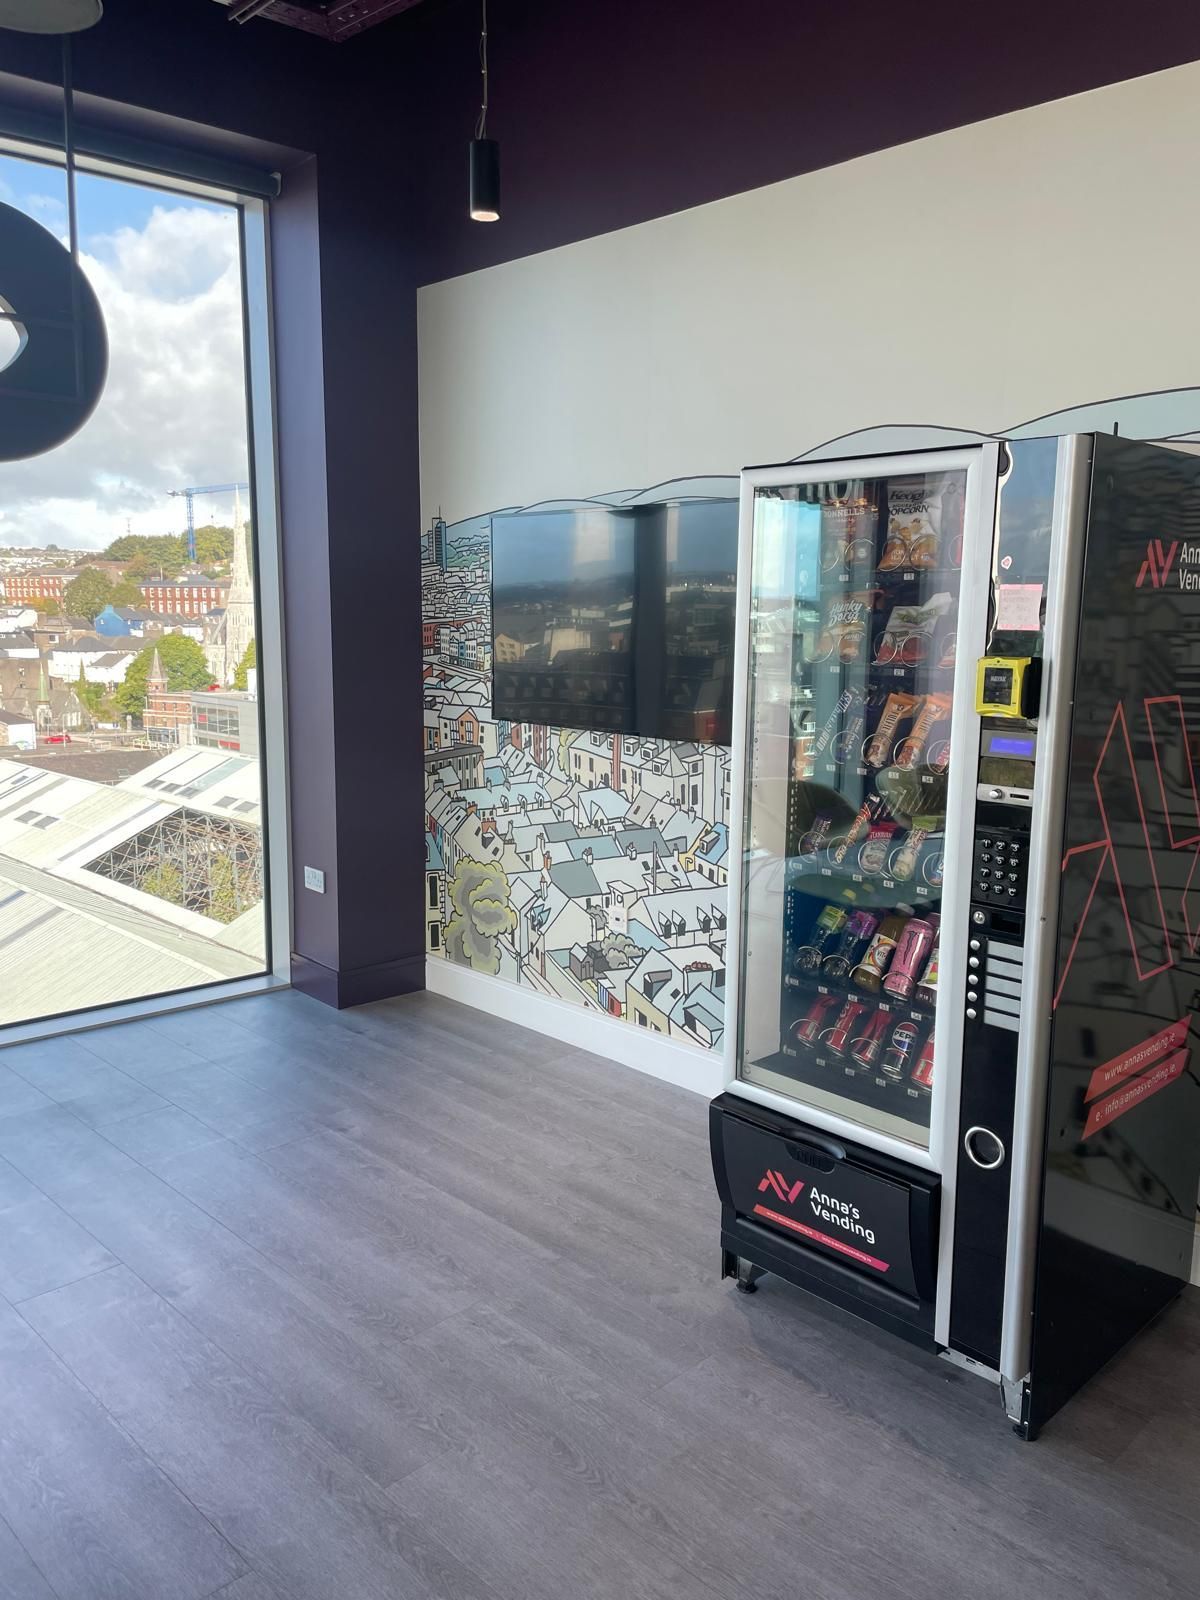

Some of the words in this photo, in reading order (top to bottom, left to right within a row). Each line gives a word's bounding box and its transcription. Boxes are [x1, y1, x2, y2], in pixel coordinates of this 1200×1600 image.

[888, 504, 930, 516] OPCORN
[1178, 567, 1200, 590] Ven
[809, 1186, 861, 1220] Anna's
[810, 1201, 876, 1245] Vending
